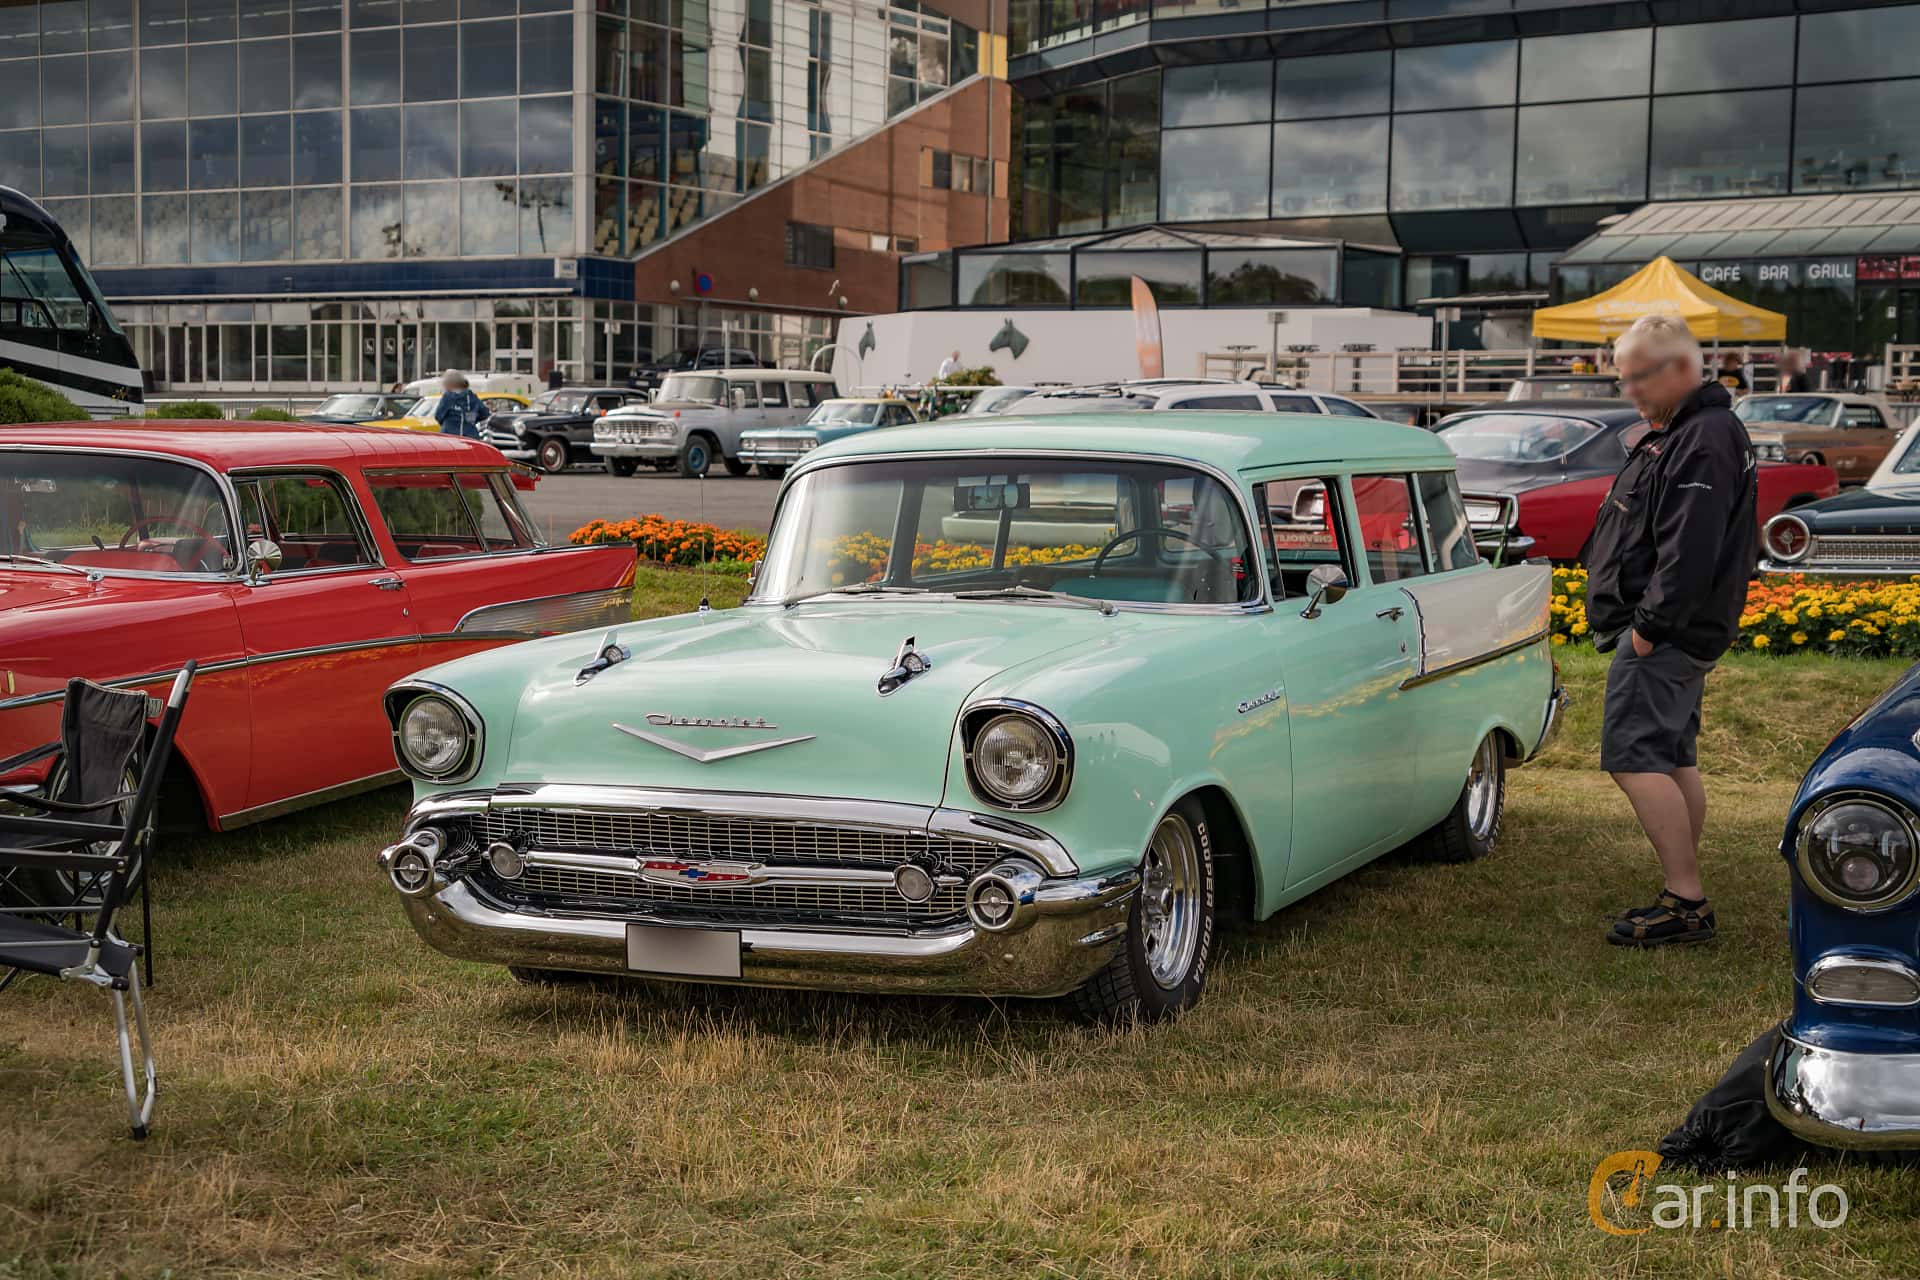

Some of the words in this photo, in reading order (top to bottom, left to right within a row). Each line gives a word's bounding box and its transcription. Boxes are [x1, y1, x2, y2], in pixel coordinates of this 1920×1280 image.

[1758, 265, 1789, 280] BAR
[1808, 264, 1852, 279] GRILL
[645, 712, 777, 729] Chevrolet
[1197, 822, 1214, 907] COOPER
[1193, 916, 1212, 984] COBRA
